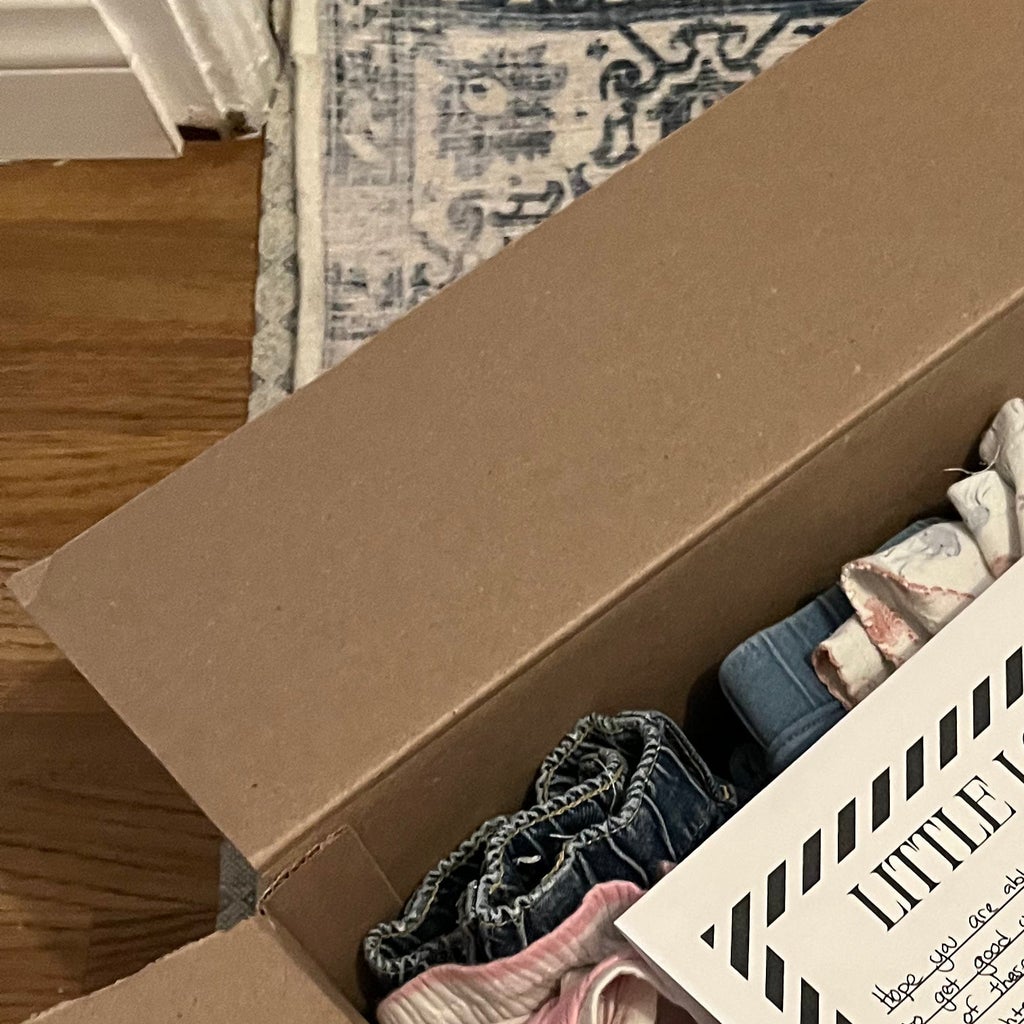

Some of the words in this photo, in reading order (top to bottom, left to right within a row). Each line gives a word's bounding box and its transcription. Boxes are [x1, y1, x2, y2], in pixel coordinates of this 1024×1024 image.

[848, 775, 1016, 931] LITTLE
[872, 974, 924, 1011] Hope
[930, 936, 957, 972] you
[969, 903, 999, 928] are
[935, 977, 962, 1011] get
[975, 930, 1014, 974] good
